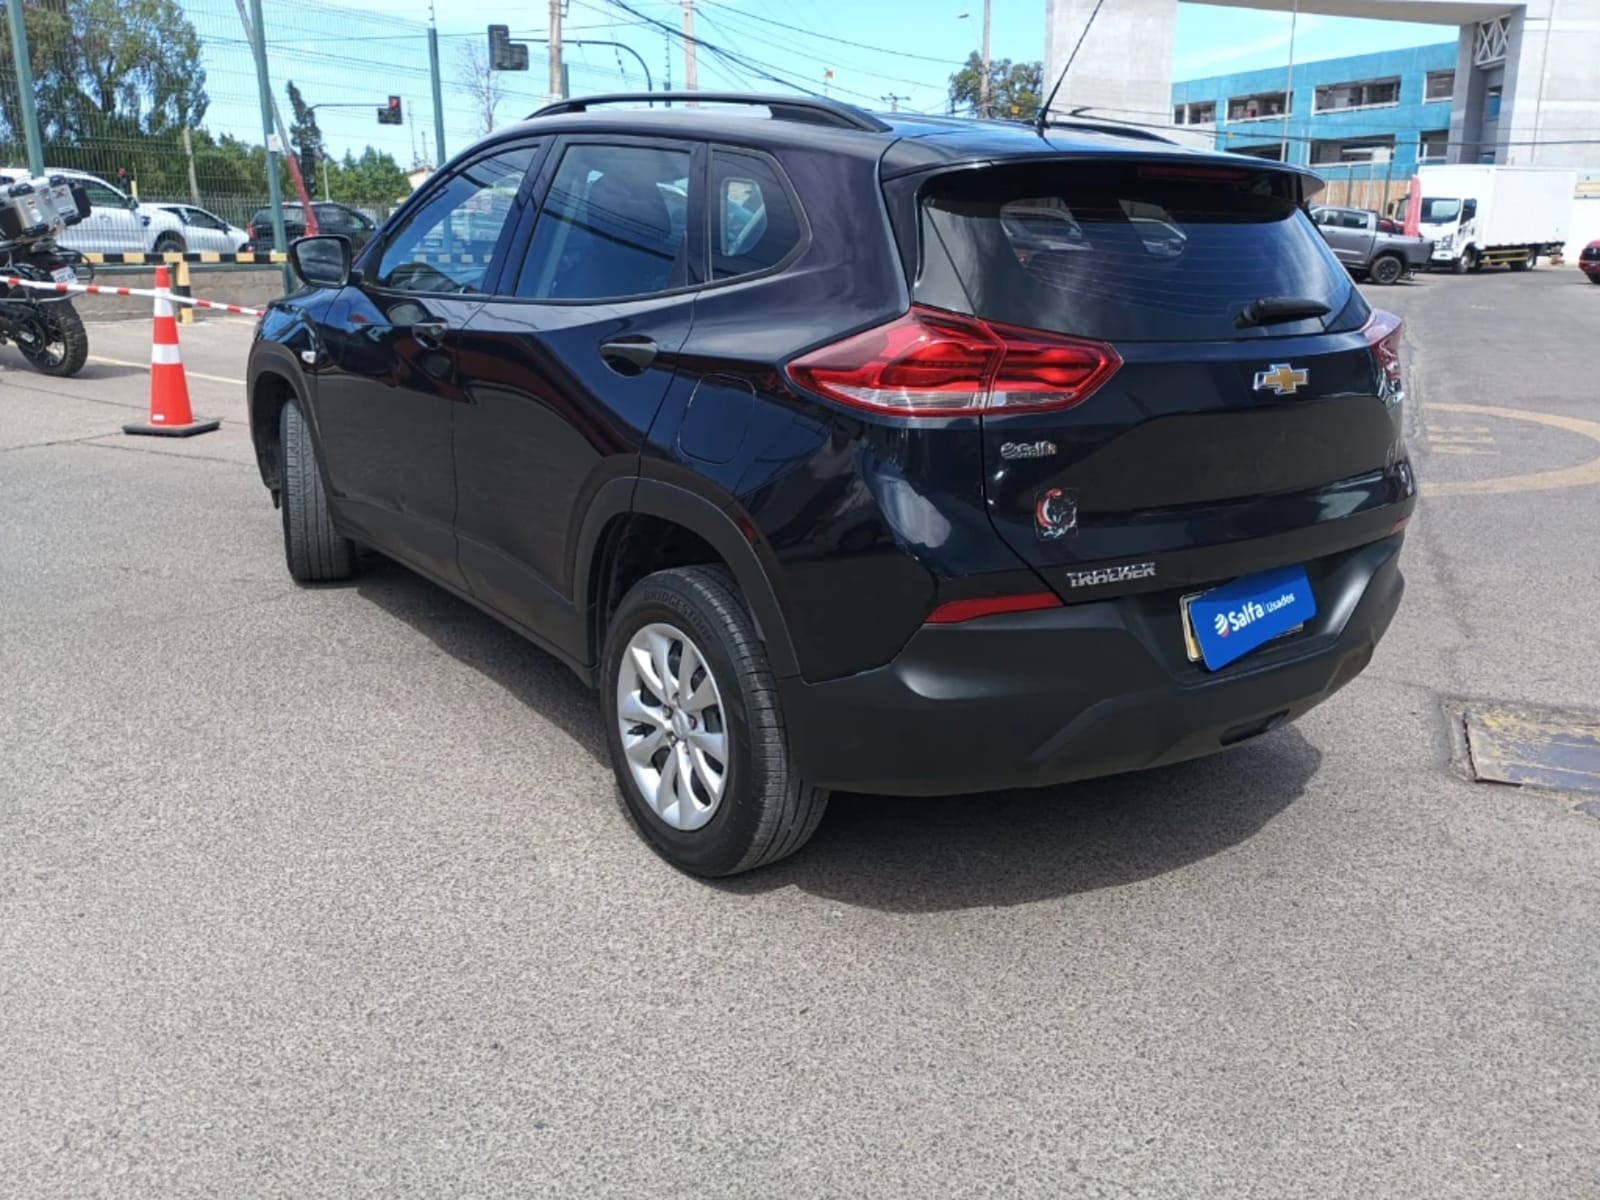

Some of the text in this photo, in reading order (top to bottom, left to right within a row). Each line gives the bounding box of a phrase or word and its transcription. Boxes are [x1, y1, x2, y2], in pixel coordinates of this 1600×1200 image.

[1066, 562, 1156, 587] TRACKER
[1228, 592, 1295, 632] Salfa Usados
